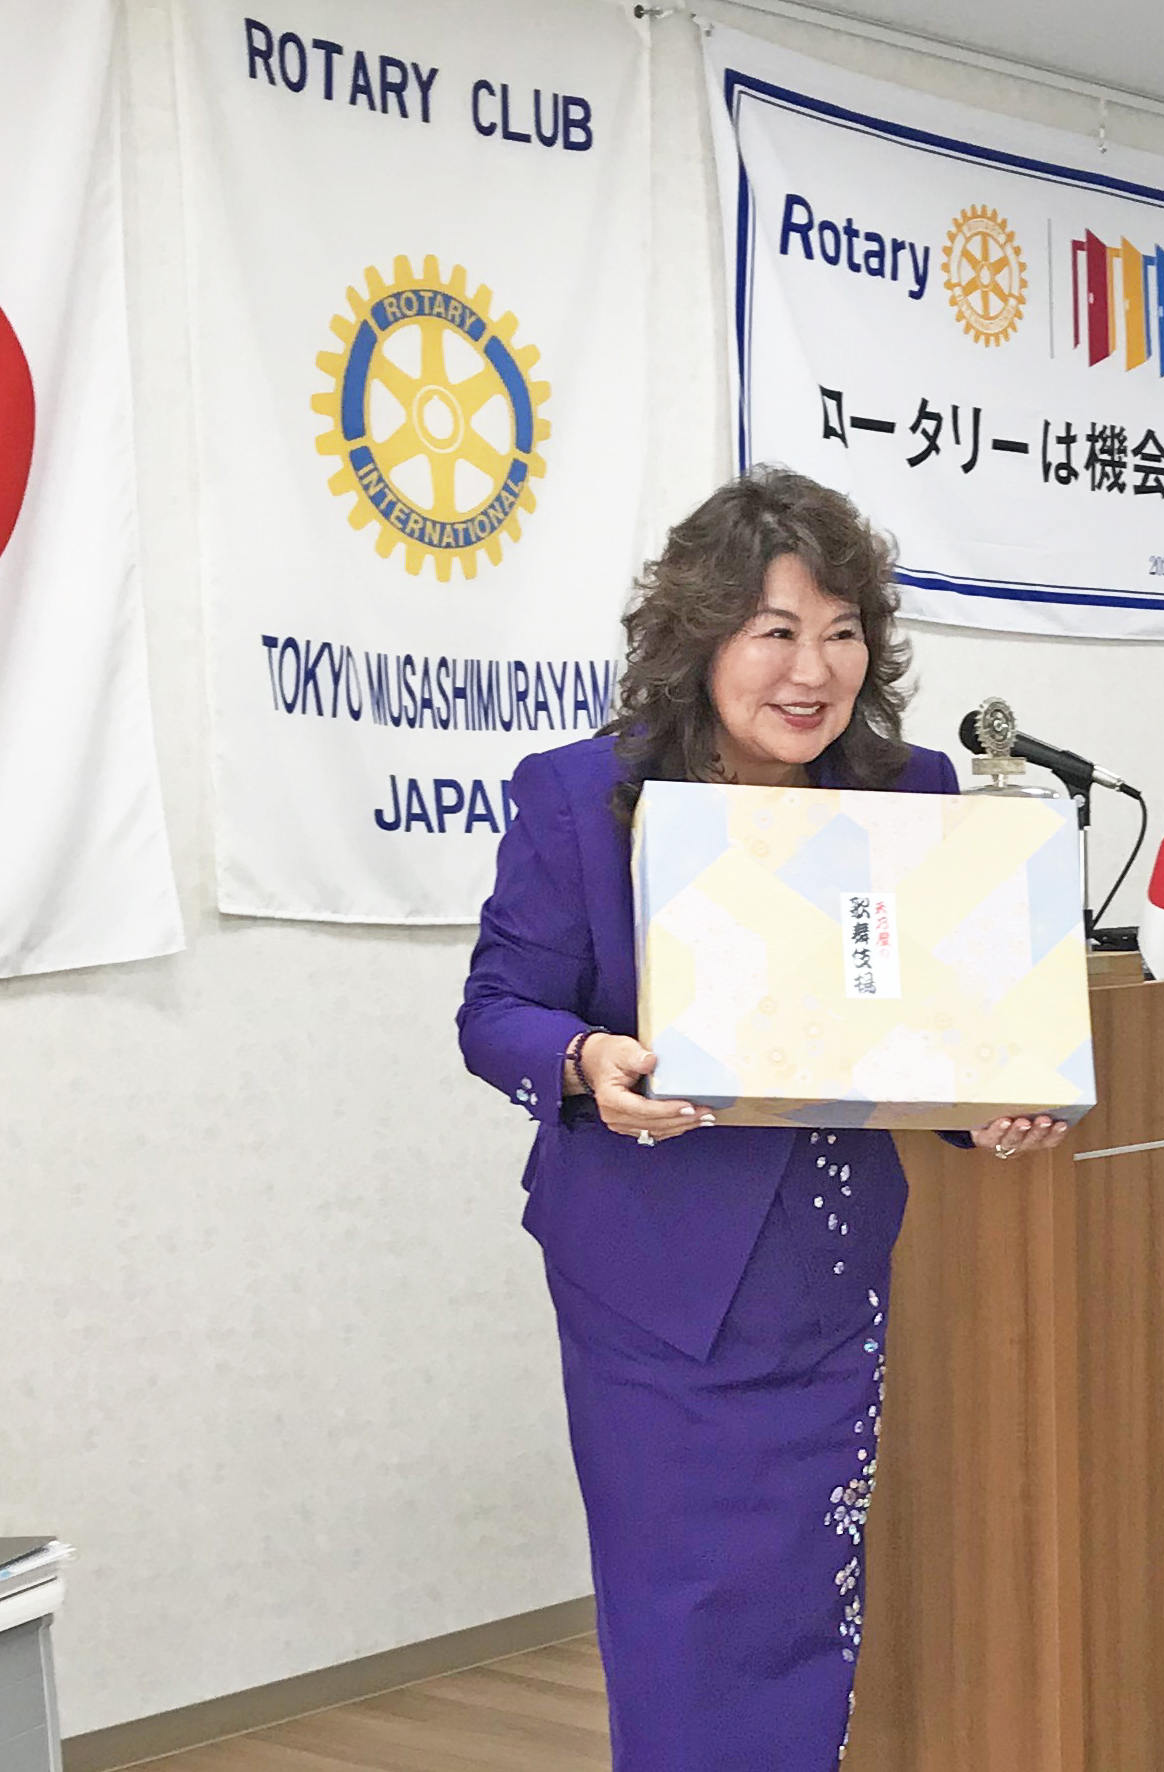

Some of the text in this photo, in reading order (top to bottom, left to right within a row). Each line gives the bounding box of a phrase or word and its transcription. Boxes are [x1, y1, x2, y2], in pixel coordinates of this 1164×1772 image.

[244, 18, 593, 152] ROTARY CLUB
[779, 194, 931, 300] Rotary
[384, 290, 479, 332] ROTARY
[357, 462, 523, 547] INTERNATIONAL
[261, 634, 619, 732] TOKYO MUSASHIMURAYAM
